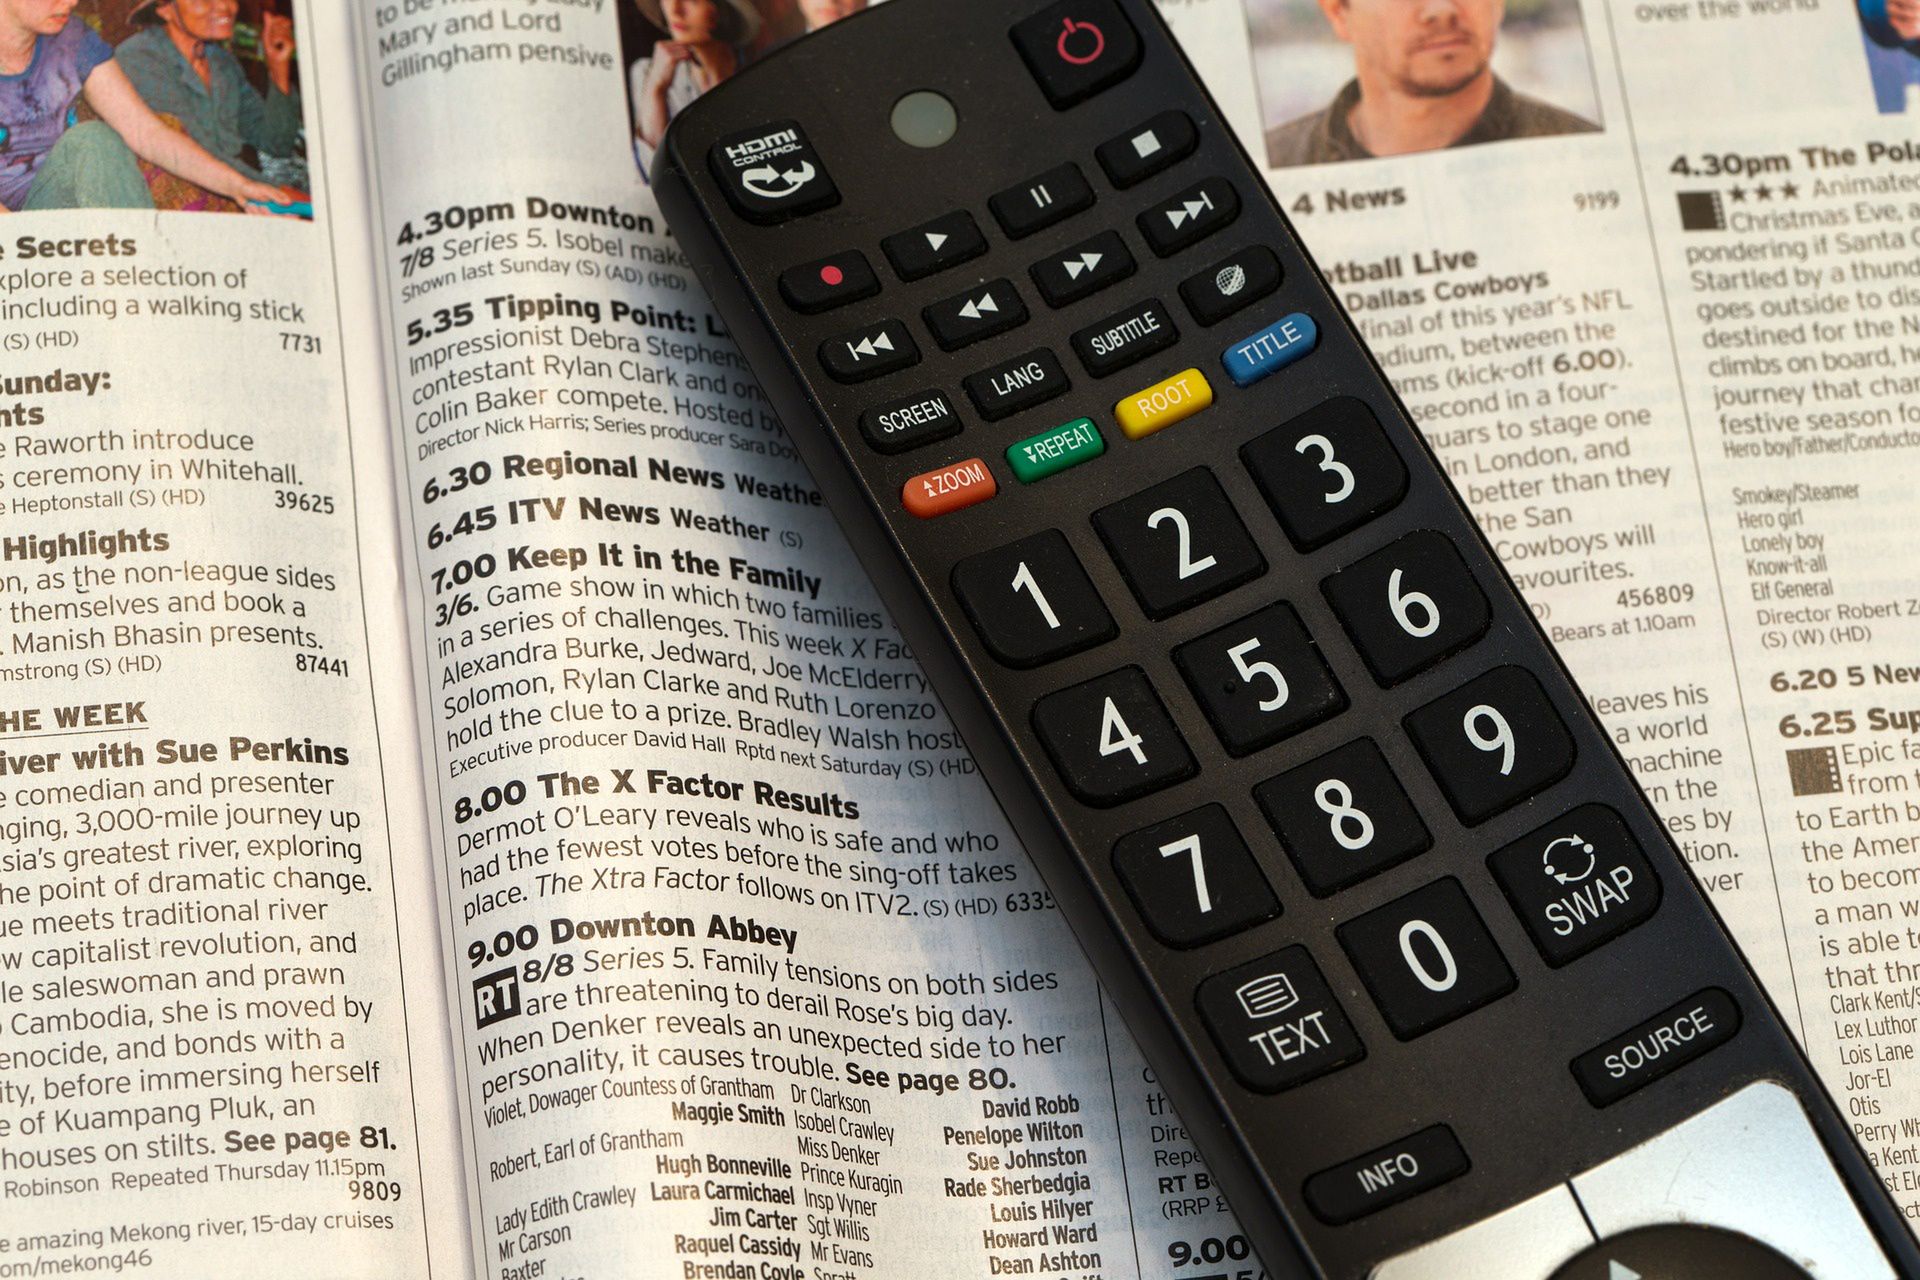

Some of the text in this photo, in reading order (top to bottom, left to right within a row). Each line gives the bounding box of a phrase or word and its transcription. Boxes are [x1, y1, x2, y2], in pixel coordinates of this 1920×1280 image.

[378, 22, 438, 58] Mary
[444, 13, 494, 36] and
[501, 9, 562, 33] Lord
[378, 42, 613, 87] Gillingham pensive
[725, 129, 798, 159] HDMI
[733, 143, 802, 167] CONTROL
[1669, 146, 1855, 179] 4.30pm The
[1291, 188, 1620, 215] 4 News 9199
[397, 196, 654, 247] 4.30pm Downton
[16, 233, 137, 259] Secrets
[401, 256, 687, 304] Shown last Sunday (S) (AD) (HD)
[1345, 272, 1549, 313] Dallas Cowboys
[2, 295, 305, 323] including a walking stick
[407, 292, 695, 346] 5.35 Tipping Point:
[3, 330, 321, 354] (S) (HD) 7731
[1091, 311, 1160, 355] SUBTITLE
[1237, 321, 1302, 365] TITLE
[991, 362, 1044, 396] LANG
[879, 398, 948, 433] SCREEN
[1136, 378, 1191, 418] ROOT
[418, 413, 766, 461] Director Nick Harris; Series producer Sara
[1034, 423, 1093, 461] REPEAT
[423, 450, 725, 504] 6.30 Regional News
[932, 463, 985, 494] ZOOM
[1295, 434, 1355, 503] 3
[12, 489, 334, 516] Heptonstall (S) (HD) 39625
[1732, 482, 1860, 506] Smokey/Steamer
[428, 497, 803, 550] 6.45 ITV News Weather (S)
[1736, 509, 1804, 532] Hero girl
[3, 528, 170, 564] Highlights
[1147, 507, 1217, 580] 2
[431, 543, 821, 600] 7.00 Keep It in the Family
[1746, 554, 1828, 577] Know-it-all
[1011, 562, 1061, 629] 1
[1388, 568, 1440, 637] 6
[1617, 583, 1694, 608] 456809
[1551, 614, 1696, 643] Bears at 1.10am
[1761, 625, 1872, 650] (S) (W) (HD)
[296, 653, 348, 678] 87441
[1227, 637, 1289, 711] 5
[1770, 666, 1865, 693] 6.20 5
[53, 701, 148, 725] WEEK
[1099, 696, 1148, 764] 4
[1779, 710, 1857, 738] 6.25
[71, 737, 349, 770] with Sue Perkins
[447, 730, 934, 780] Executive producer David Hall Rptd next Saturday (S)
[1464, 705, 1515, 775] 9
[455, 769, 859, 824] 8.00 The X Factor Results
[1314, 779, 1374, 850] 8
[1795, 802, 1898, 832] to Earth
[1159, 834, 1212, 913] 7
[1544, 865, 1633, 936] SWAP
[468, 911, 797, 969] 9.00 Downton Abbey
[1399, 920, 1457, 991] 0
[523, 946, 694, 983] 8/8 Series 5.
[477, 976, 515, 1020] RT
[1249, 1010, 1331, 1065] TEXT
[1604, 1007, 1714, 1078] SOURCE
[1834, 1015, 1918, 1040] Lex Luthor
[1839, 1043, 1914, 1065] Lois Lane
[846, 1062, 1016, 1096] See page 80.
[1845, 1068, 1891, 1091] Jor-El
[484, 1074, 775, 1128] Violet, Dowager Countess of Grantham
[672, 1101, 785, 1127] Maggie Smith
[791, 1084, 871, 1114] Dr Clarkson
[982, 1093, 1079, 1119] David Robb
[1849, 1095, 1881, 1117] Otis
[2, 1126, 397, 1170] houses on stilts. See page 81.
[656, 1153, 792, 1179] Hugh Bonneville
[4, 1158, 385, 1199] Robinson Repeated Thursday 11.15pm
[349, 1180, 401, 1202] 9809
[800, 1161, 903, 1197] Prince Kuragin
[944, 1171, 1091, 1197] Rade Sherbedgia
[1357, 1153, 1418, 1193] INFO
[16, 1210, 394, 1252] amazing Mekong river, 15-day cruises
[1168, 1235, 1249, 1268] 9.00
